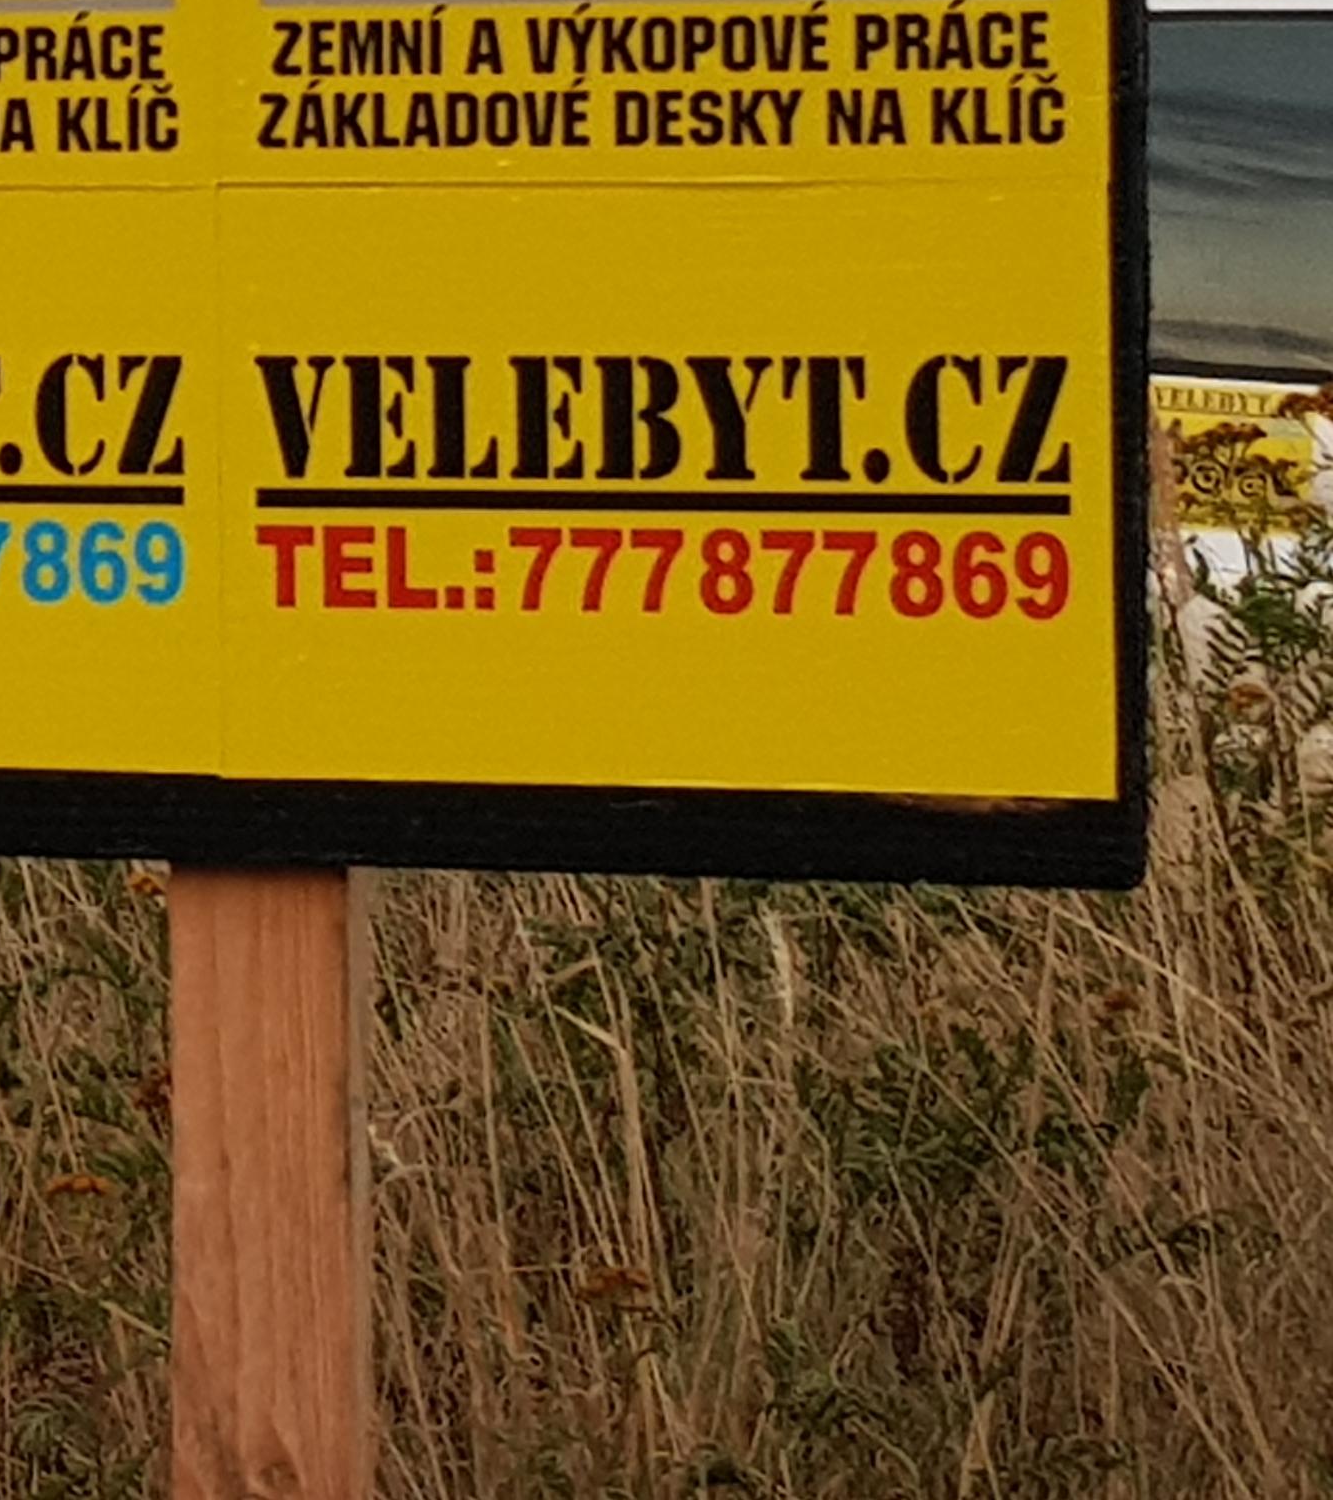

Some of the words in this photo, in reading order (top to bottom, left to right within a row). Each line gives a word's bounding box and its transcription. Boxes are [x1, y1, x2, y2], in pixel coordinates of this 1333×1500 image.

[271, 3, 447, 77] ZEMNÍ
[465, 17, 504, 76] A
[57, 83, 179, 153] KLÍČ
[256, 76, 591, 150] ZÁKLADOVÉ
[614, 88, 804, 147] DESKY
[826, 87, 908, 146] NA
[930, 72, 1066, 146] KLÍČ
[253, 354, 1072, 486] VELEBYT.CZ
[254, 523, 1071, 622] TEL.:777877869
